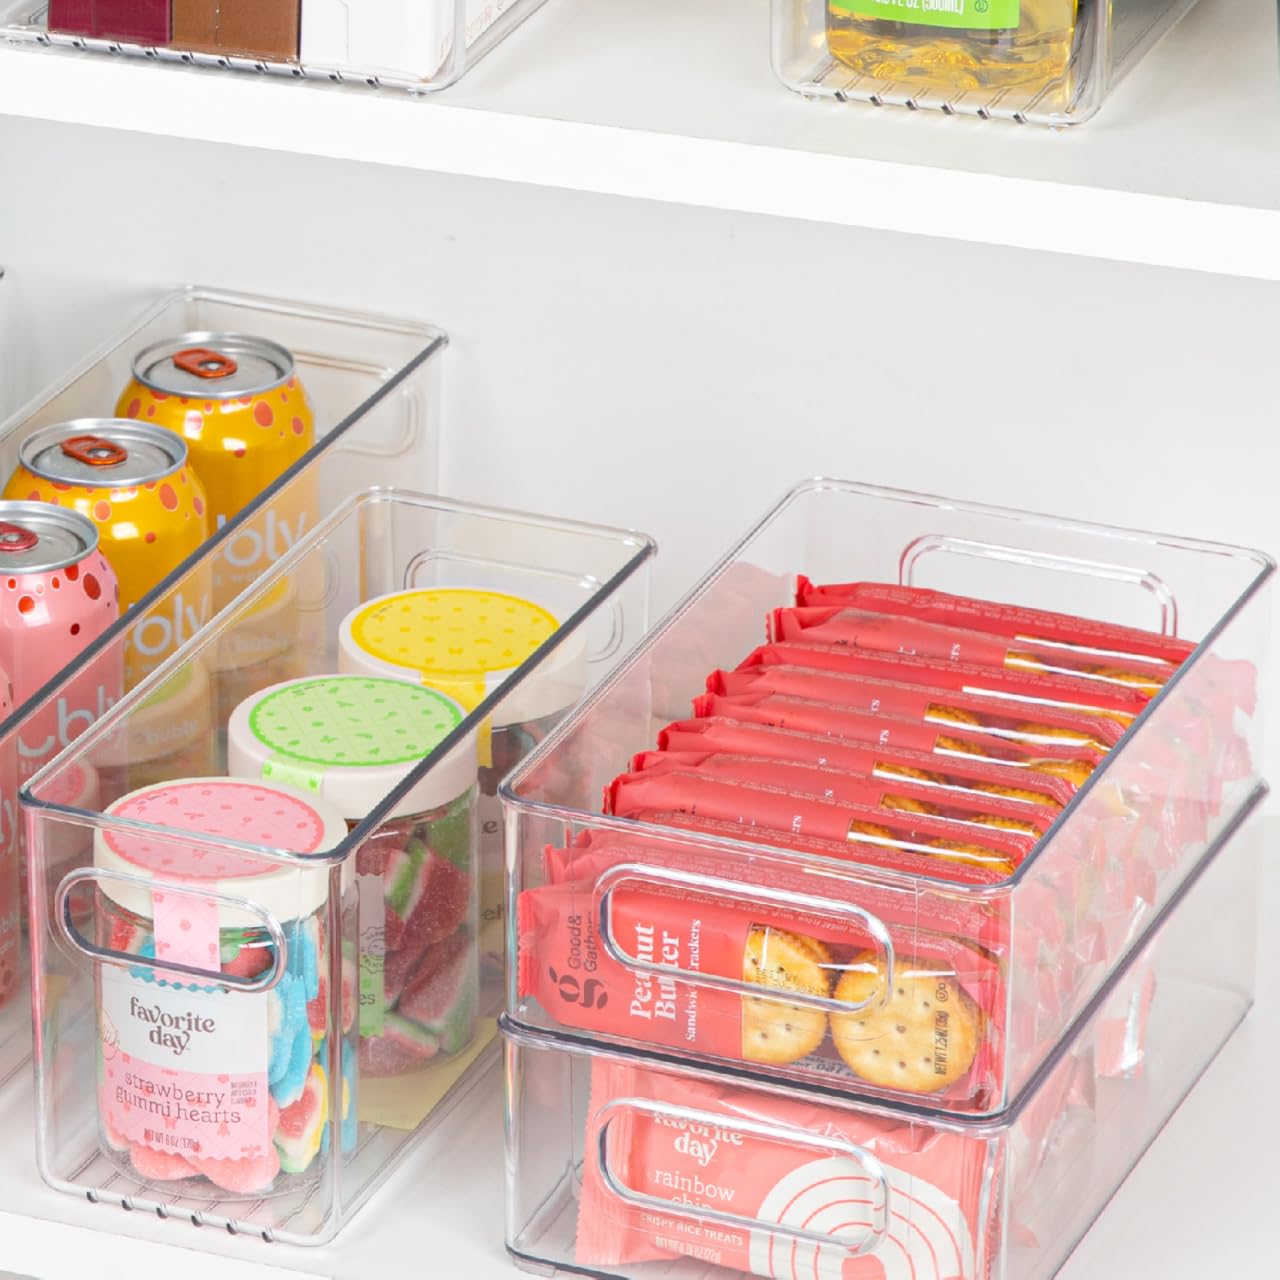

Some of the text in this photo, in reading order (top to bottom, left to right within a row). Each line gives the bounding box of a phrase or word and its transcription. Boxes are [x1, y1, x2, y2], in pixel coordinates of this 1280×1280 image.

[130, 996, 216, 1033] favorite
[149, 1025, 191, 1056] day
[116, 1086, 241, 1124] gummi hearts
[125, 1072, 225, 1109] strawberry
[674, 1132, 718, 1167] day
[654, 1169, 735, 1201] rainbow
[640, 1213, 743, 1246] CRISPY RICE TREATS
